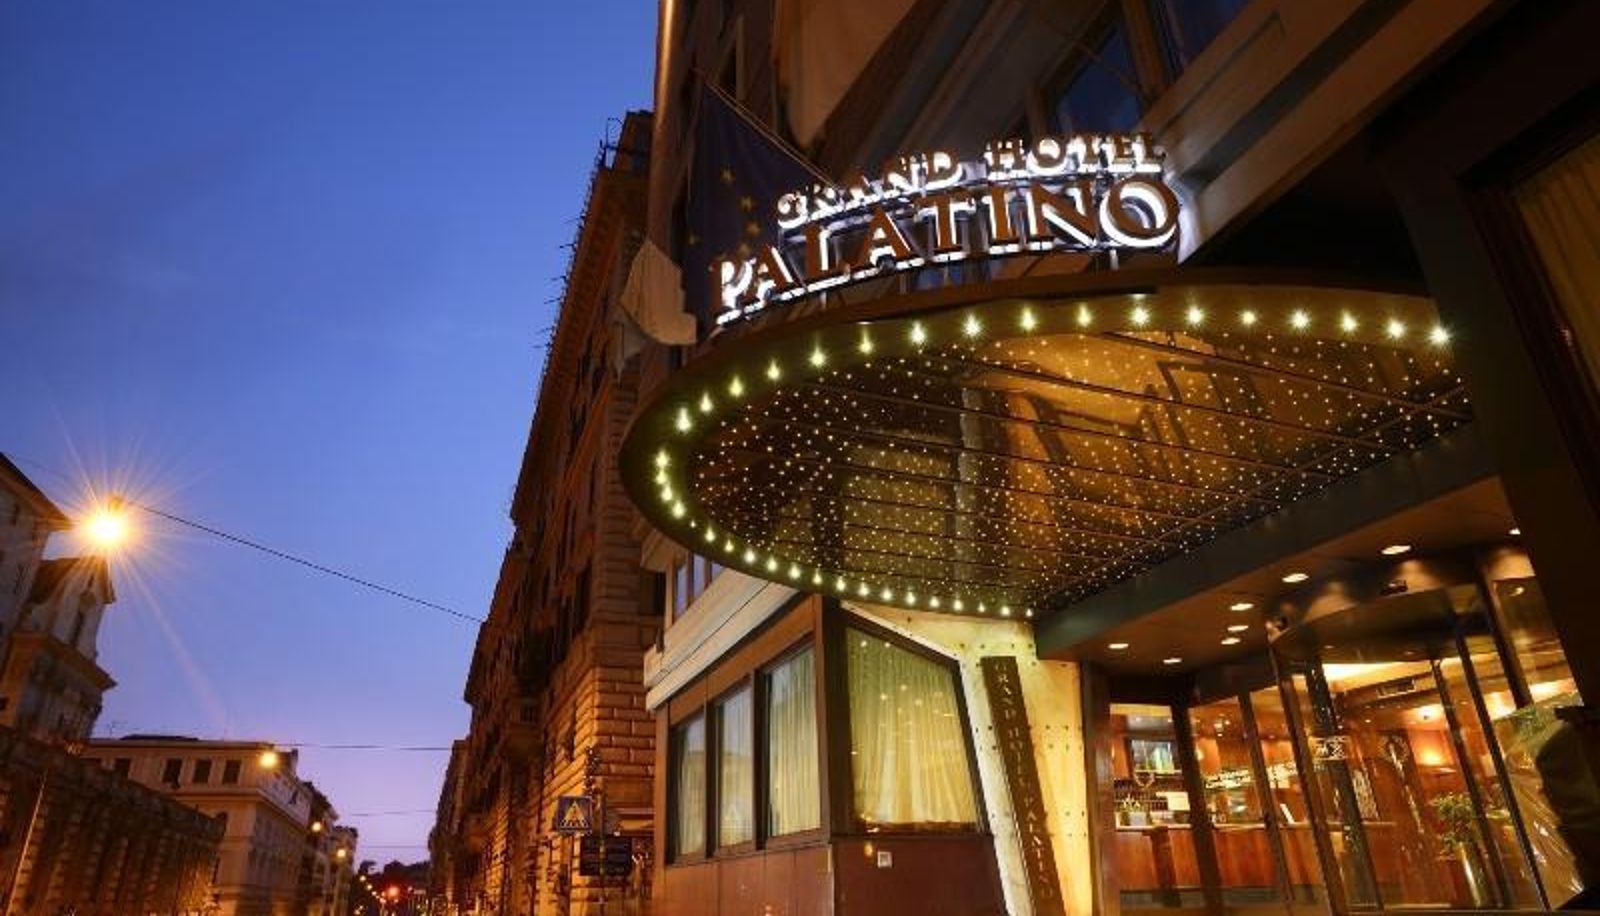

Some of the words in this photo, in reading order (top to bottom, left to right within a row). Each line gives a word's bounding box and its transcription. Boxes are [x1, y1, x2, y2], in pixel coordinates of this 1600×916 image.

[774, 150, 965, 229] GRAND
[984, 132, 1163, 179] HOTEL
[707, 175, 1181, 322] PALATINO
